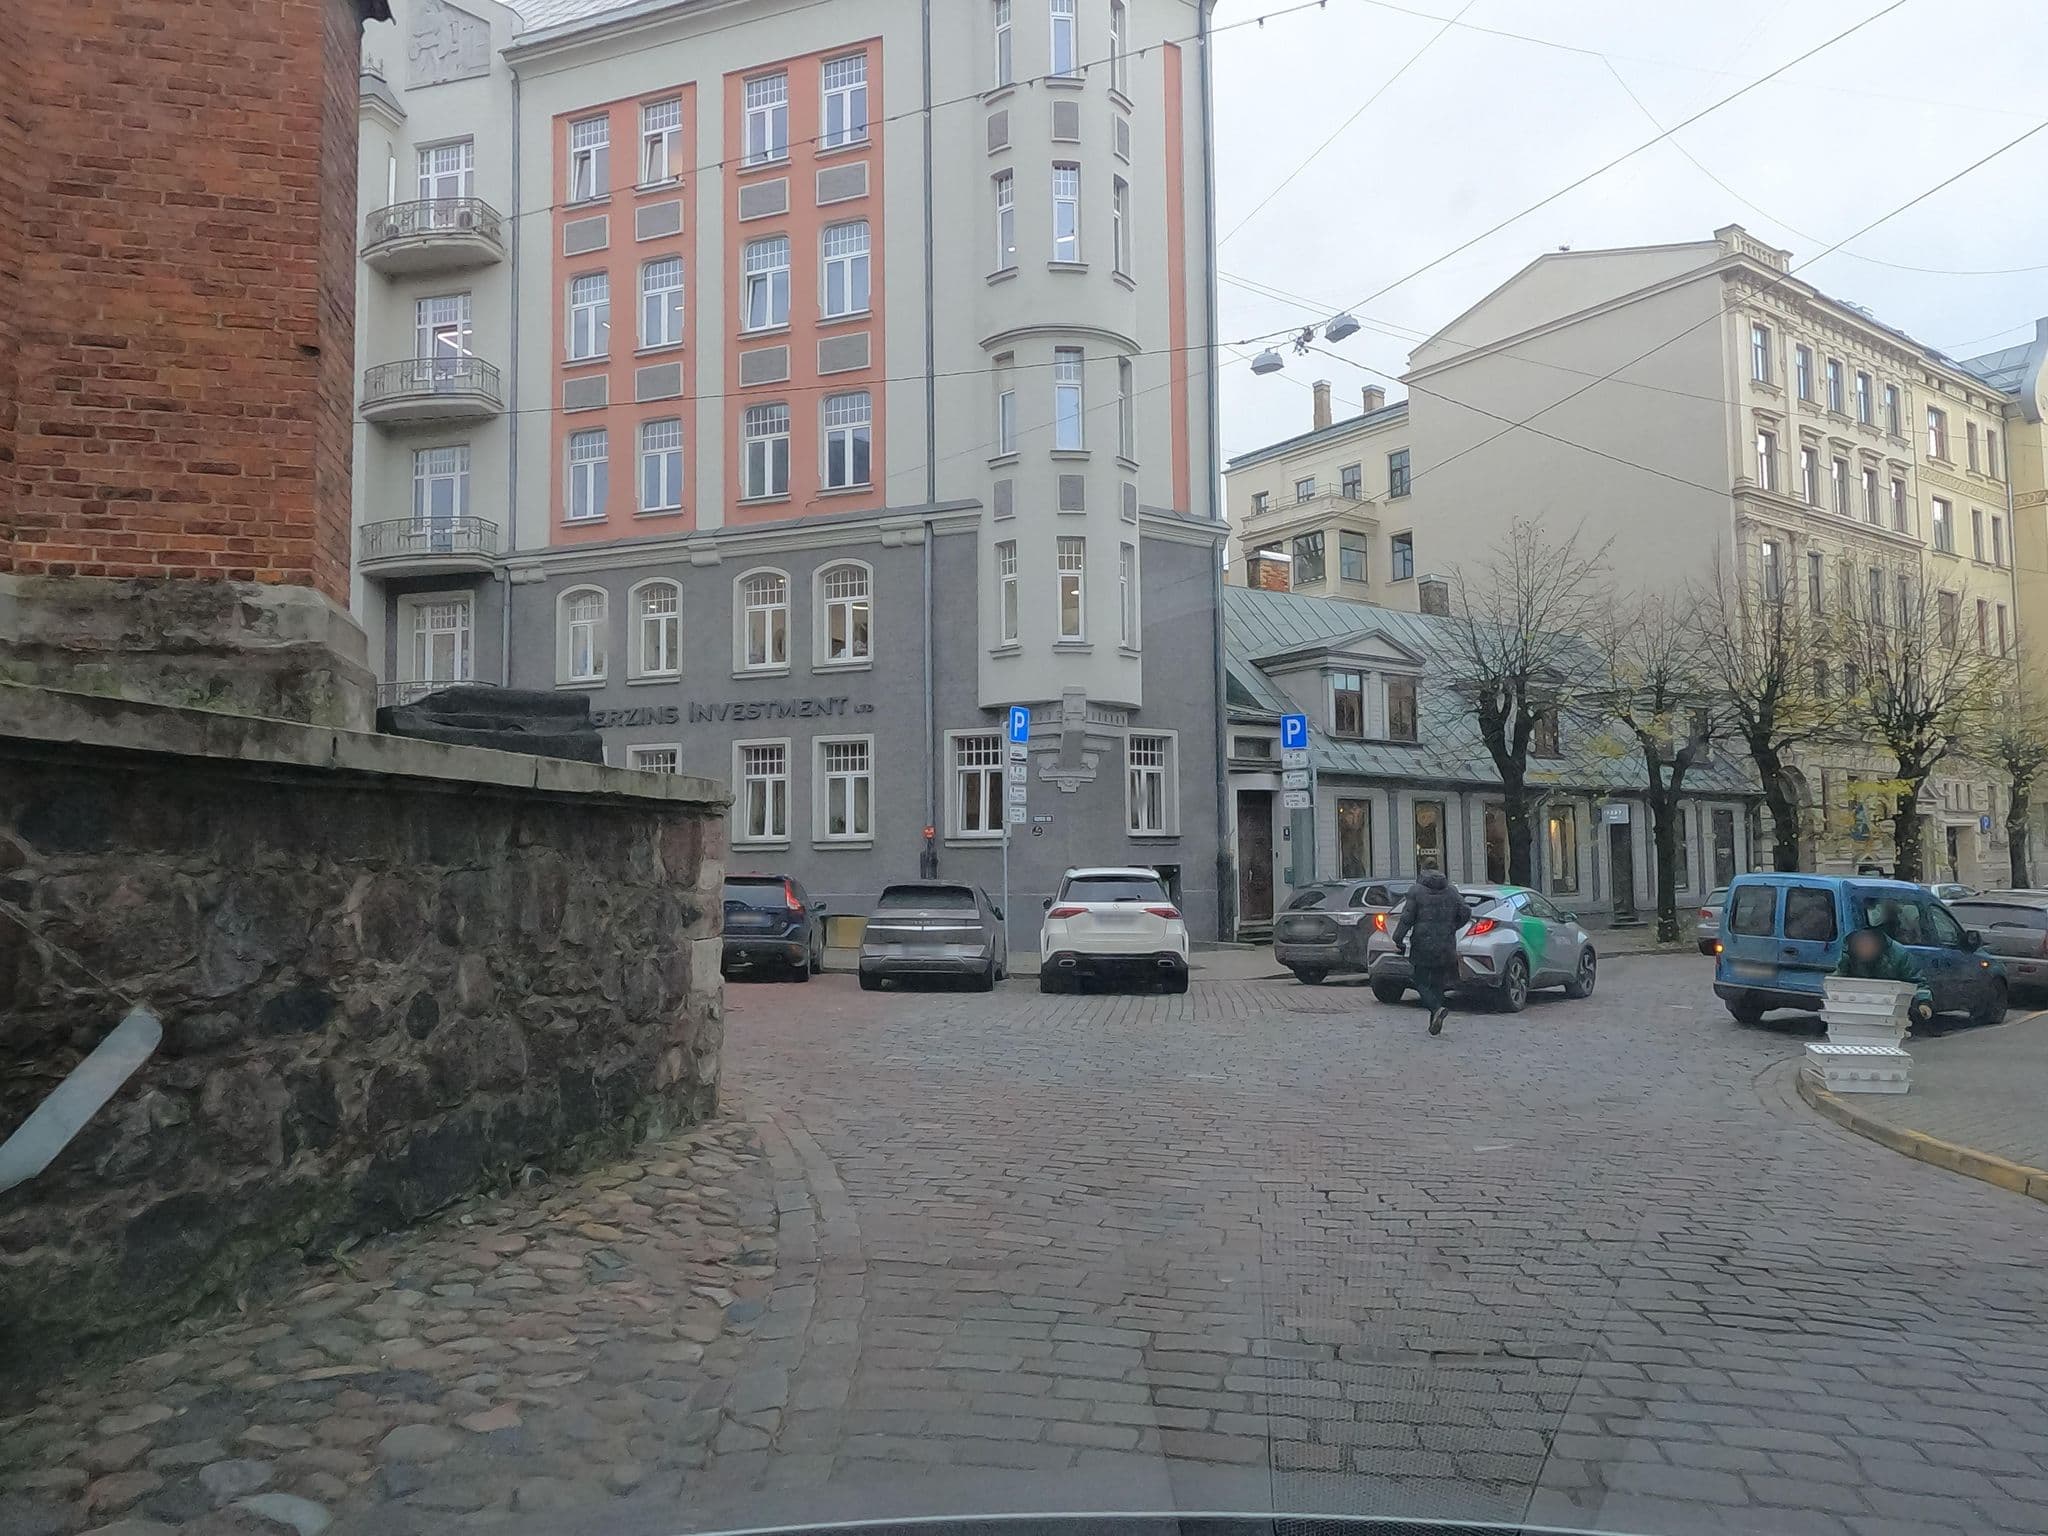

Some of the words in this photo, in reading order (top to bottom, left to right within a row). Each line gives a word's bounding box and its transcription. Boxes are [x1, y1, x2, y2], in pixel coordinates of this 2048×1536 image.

[589, 706, 679, 728] ERZINS
[1014, 711, 1025, 738] P
[1287, 719, 1301, 745] P
